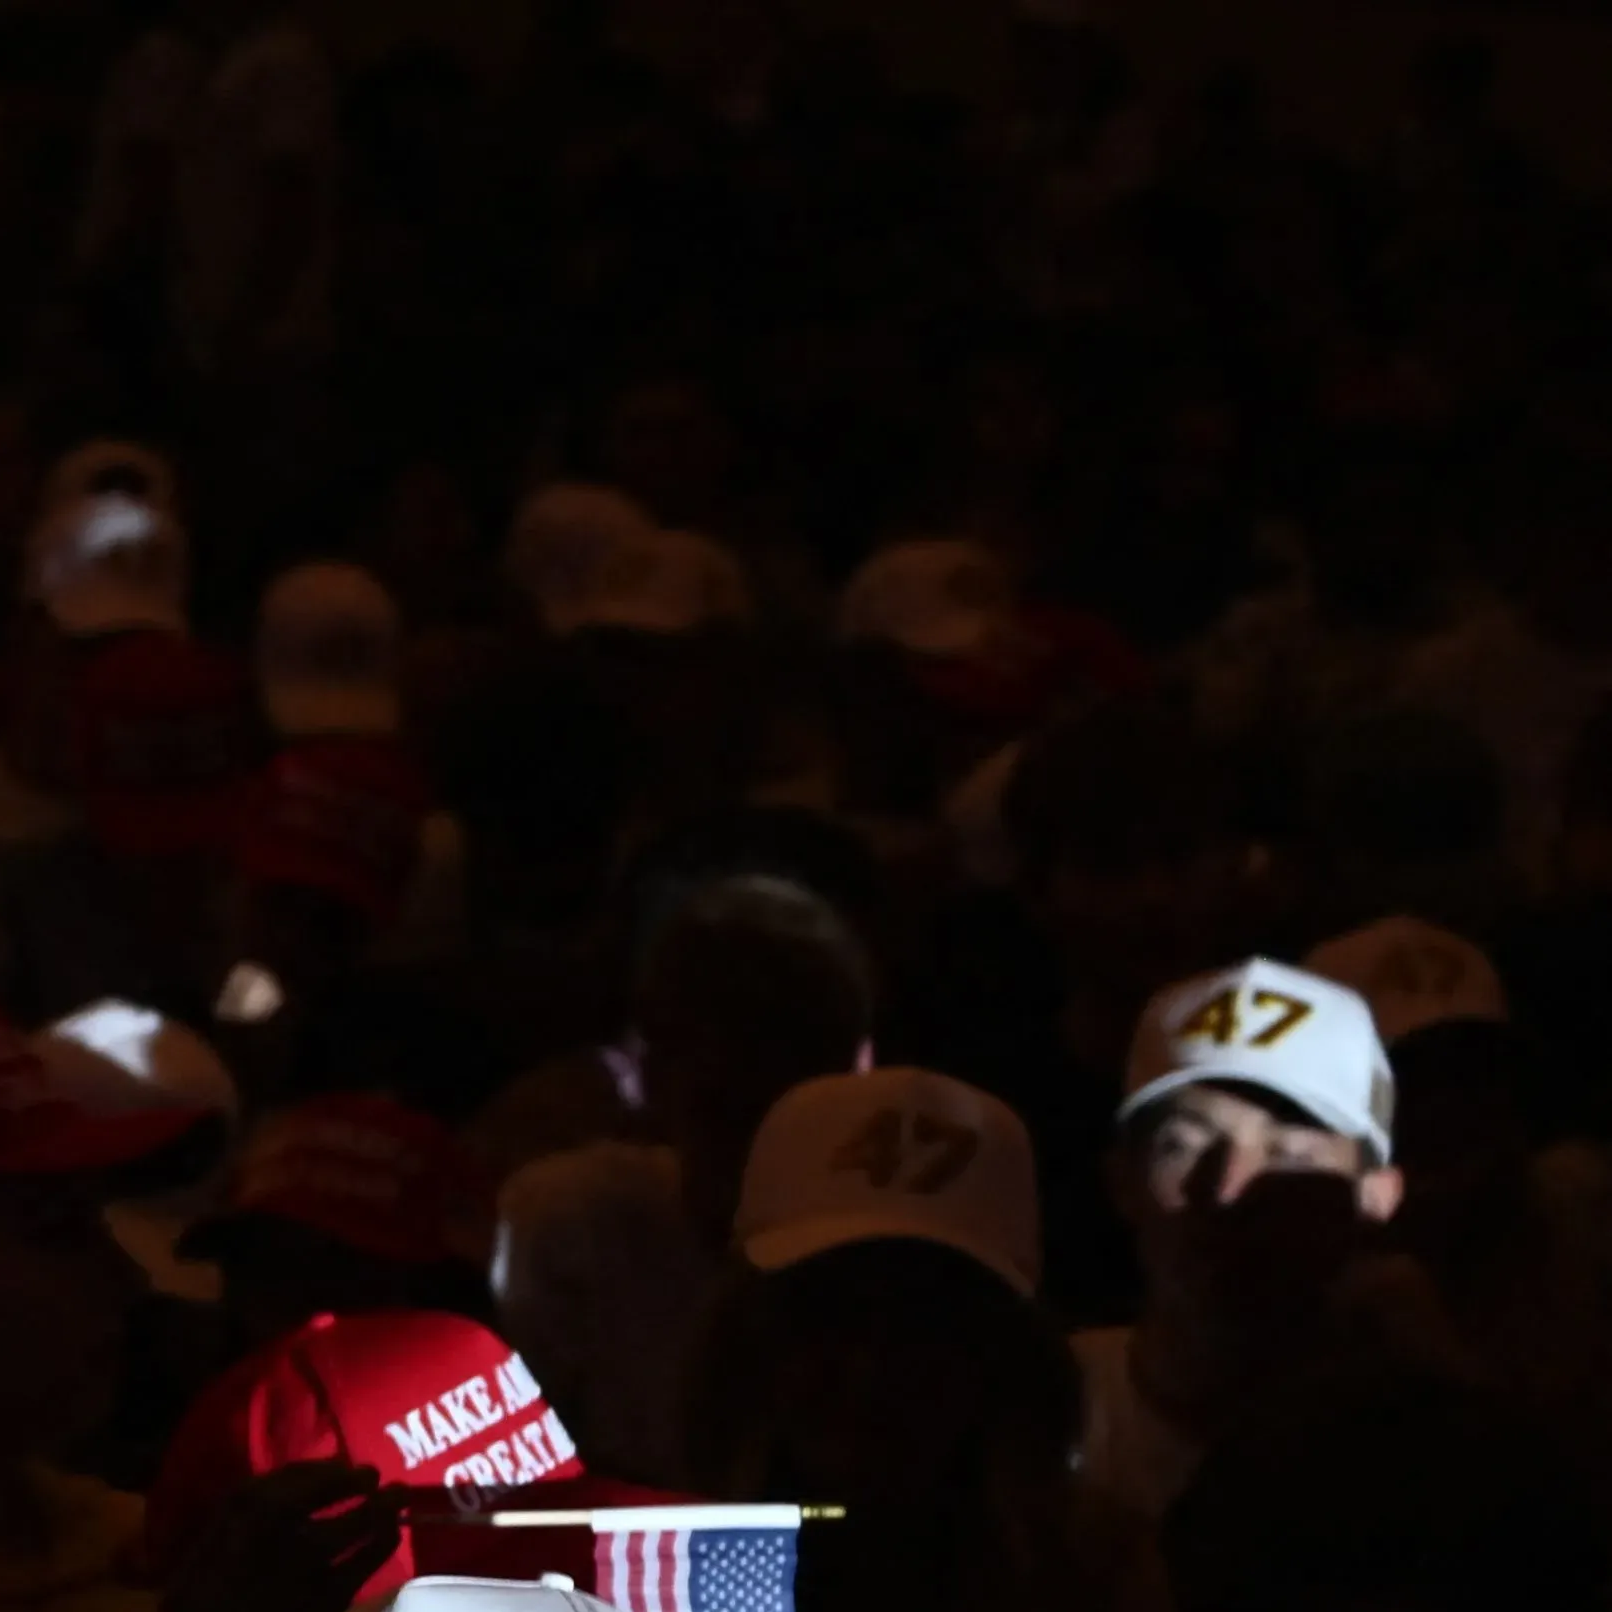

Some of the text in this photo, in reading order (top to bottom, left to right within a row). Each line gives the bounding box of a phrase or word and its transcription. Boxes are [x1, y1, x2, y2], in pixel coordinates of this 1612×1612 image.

[1178, 988, 1313, 1046] 47
[830, 1108, 978, 1193] 47
[384, 1367, 506, 1471] MAKE
